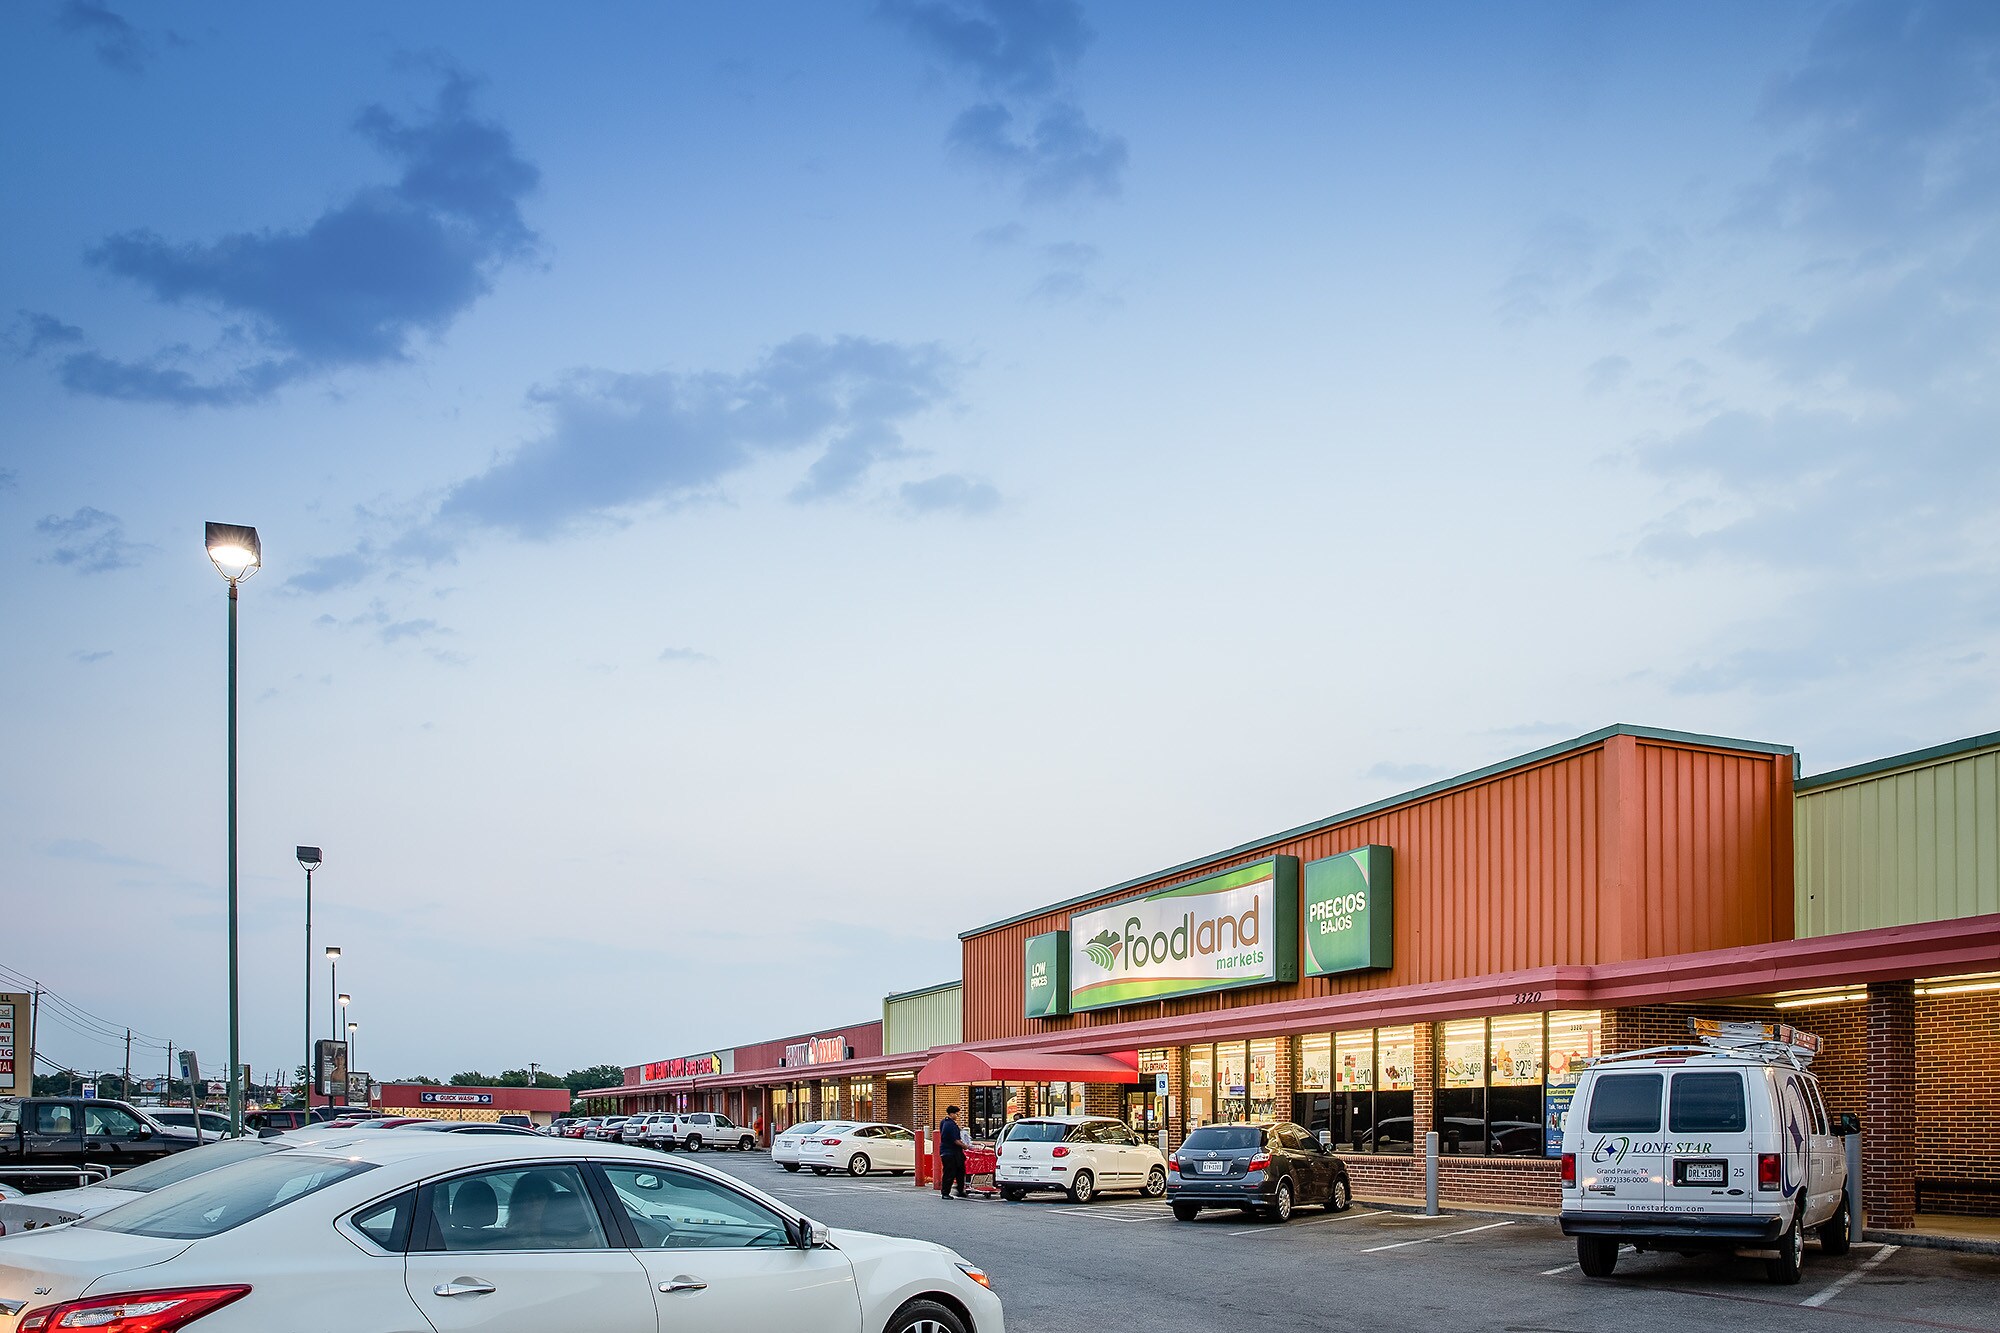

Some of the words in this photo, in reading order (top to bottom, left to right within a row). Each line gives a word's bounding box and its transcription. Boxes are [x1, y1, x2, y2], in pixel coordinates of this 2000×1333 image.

[1309, 891, 1366, 922] PRECIOS
[1320, 914, 1353, 935] BAJOS
[1124, 894, 1260, 971] foodland
[1216, 950, 1265, 970] markets
[1031, 961, 1047, 977] LOW
[1030, 975, 1048, 990] PRICES
[1512, 991, 1542, 1005] 3320
[0, 1049, 13, 1057] IG
[817, 1036, 844, 1064] DOLLAR
[1149, 1061, 1168, 1072] ENTRANCE
[1632, 1142, 1673, 1154] LONE
[1674, 1142, 1713, 1154] STAR
[1596, 1167, 1616, 1176] Grand
[1616, 1167, 1640, 1176] Prairie,
[1640, 1167, 1649, 1176] TX
[1733, 1168, 1745, 1178] 25
[1602, 1176, 1649, 1184] (972)336-0000
[1626, 1203, 1705, 1213] lonestarcom.com
[34, 1287, 52, 1296] SV
